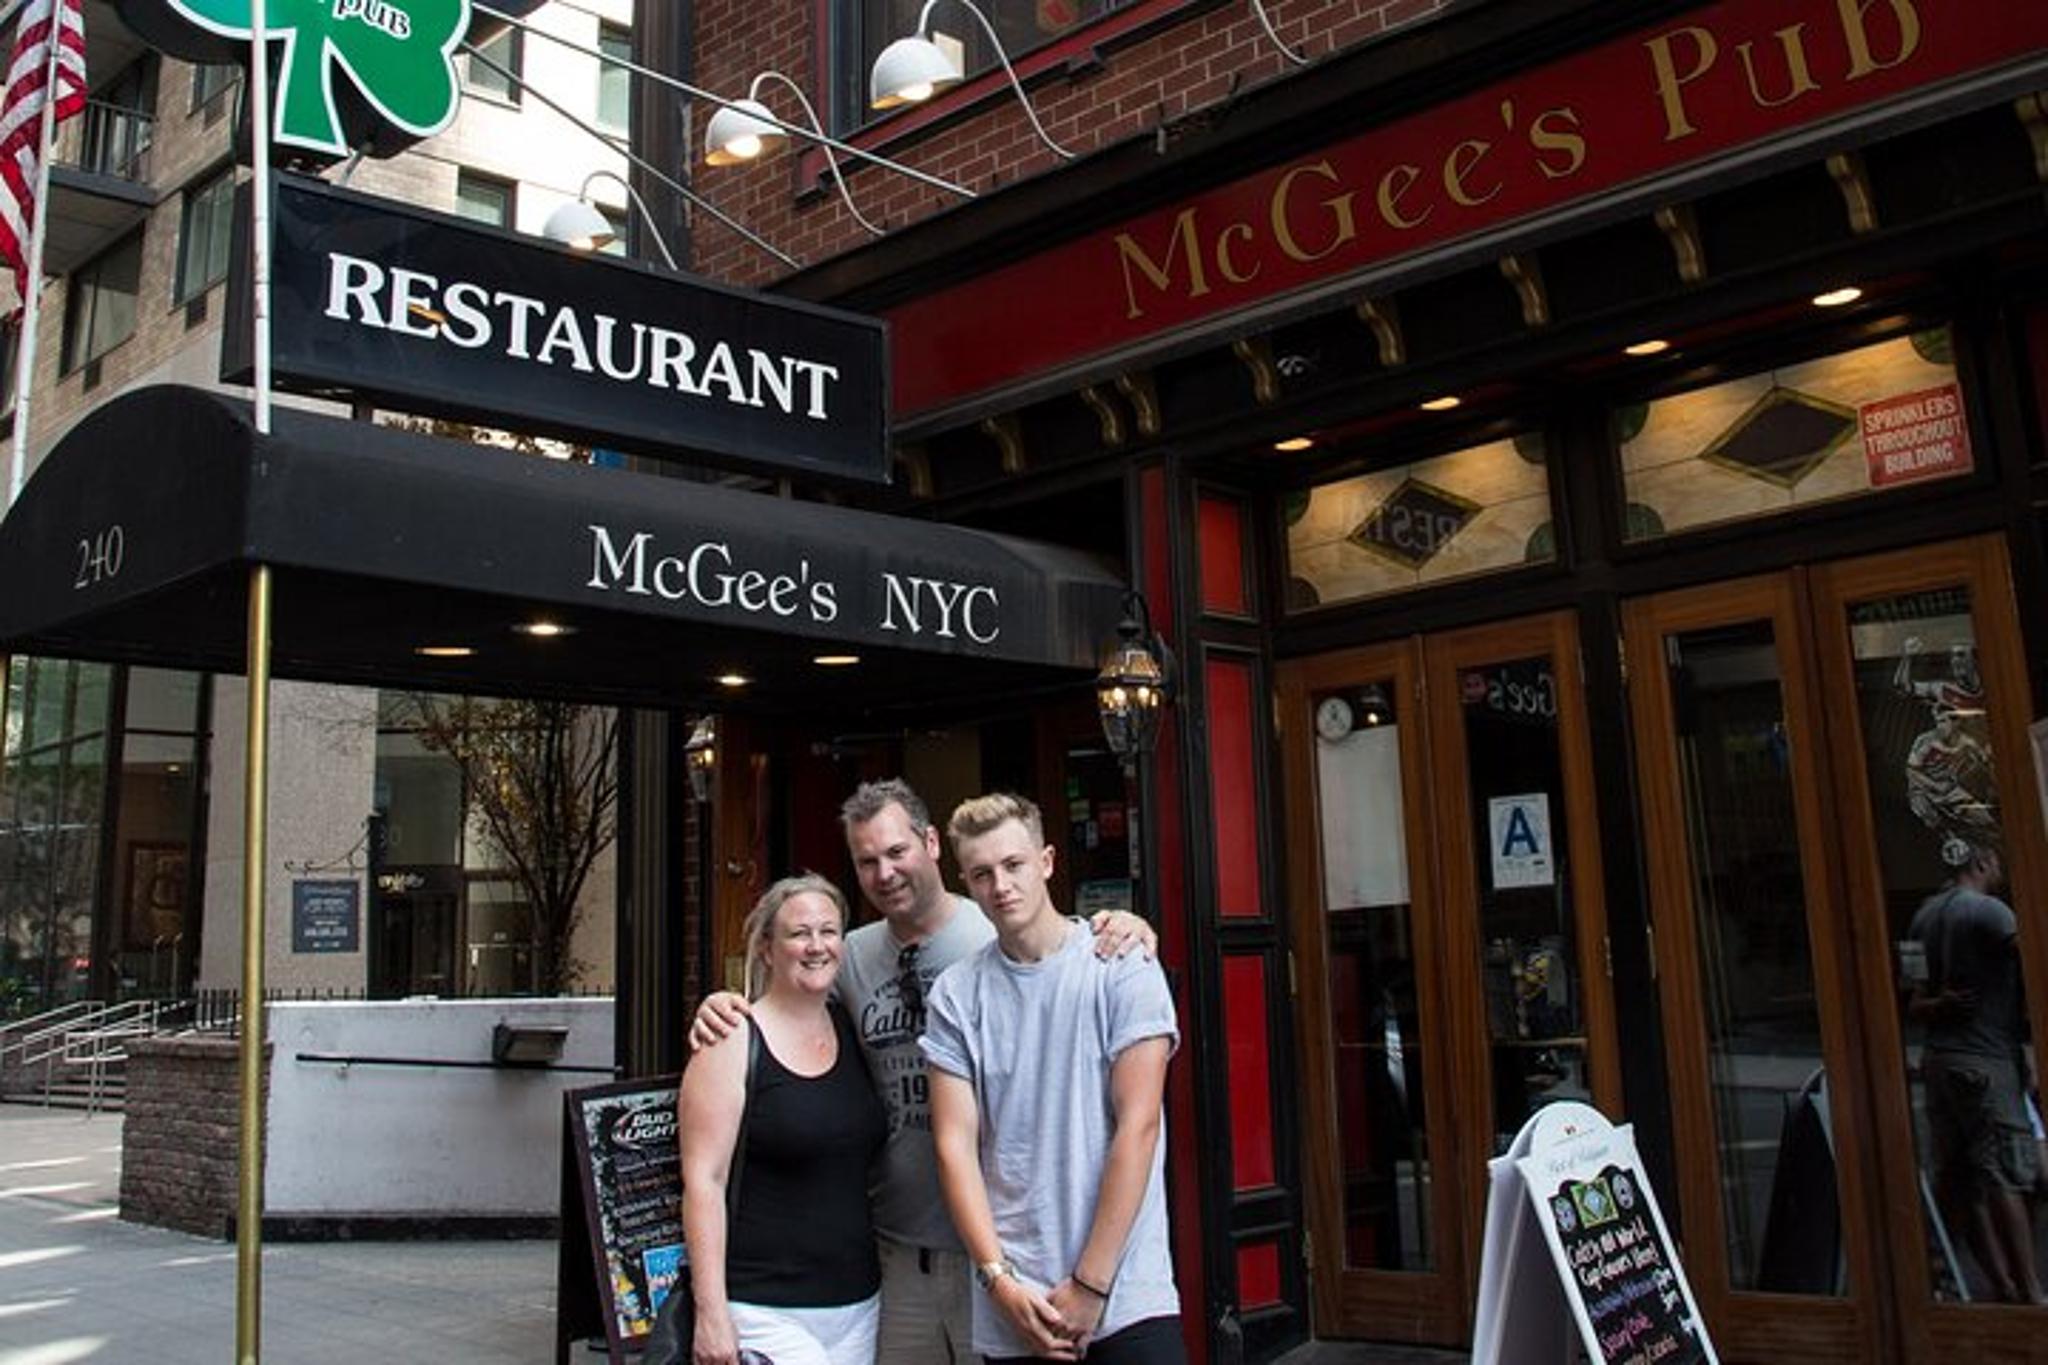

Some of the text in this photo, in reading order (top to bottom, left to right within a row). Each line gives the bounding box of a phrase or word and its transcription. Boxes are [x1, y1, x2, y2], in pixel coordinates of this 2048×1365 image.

[1114, 0, 1922, 321] McGee's Pub
[324, 252, 839, 420] RESTAURANT
[1865, 395, 1957, 433] SPRINKLERS
[1865, 414, 1963, 456] THROUGHOUT
[1884, 441, 1955, 474] BUILDING
[74, 525, 123, 589] 240
[586, 524, 1000, 644] McGee's NYC
[1502, 806, 1539, 857] A
[624, 1122, 679, 1141] LIGHT
[631, 1111, 673, 1128] BUD
